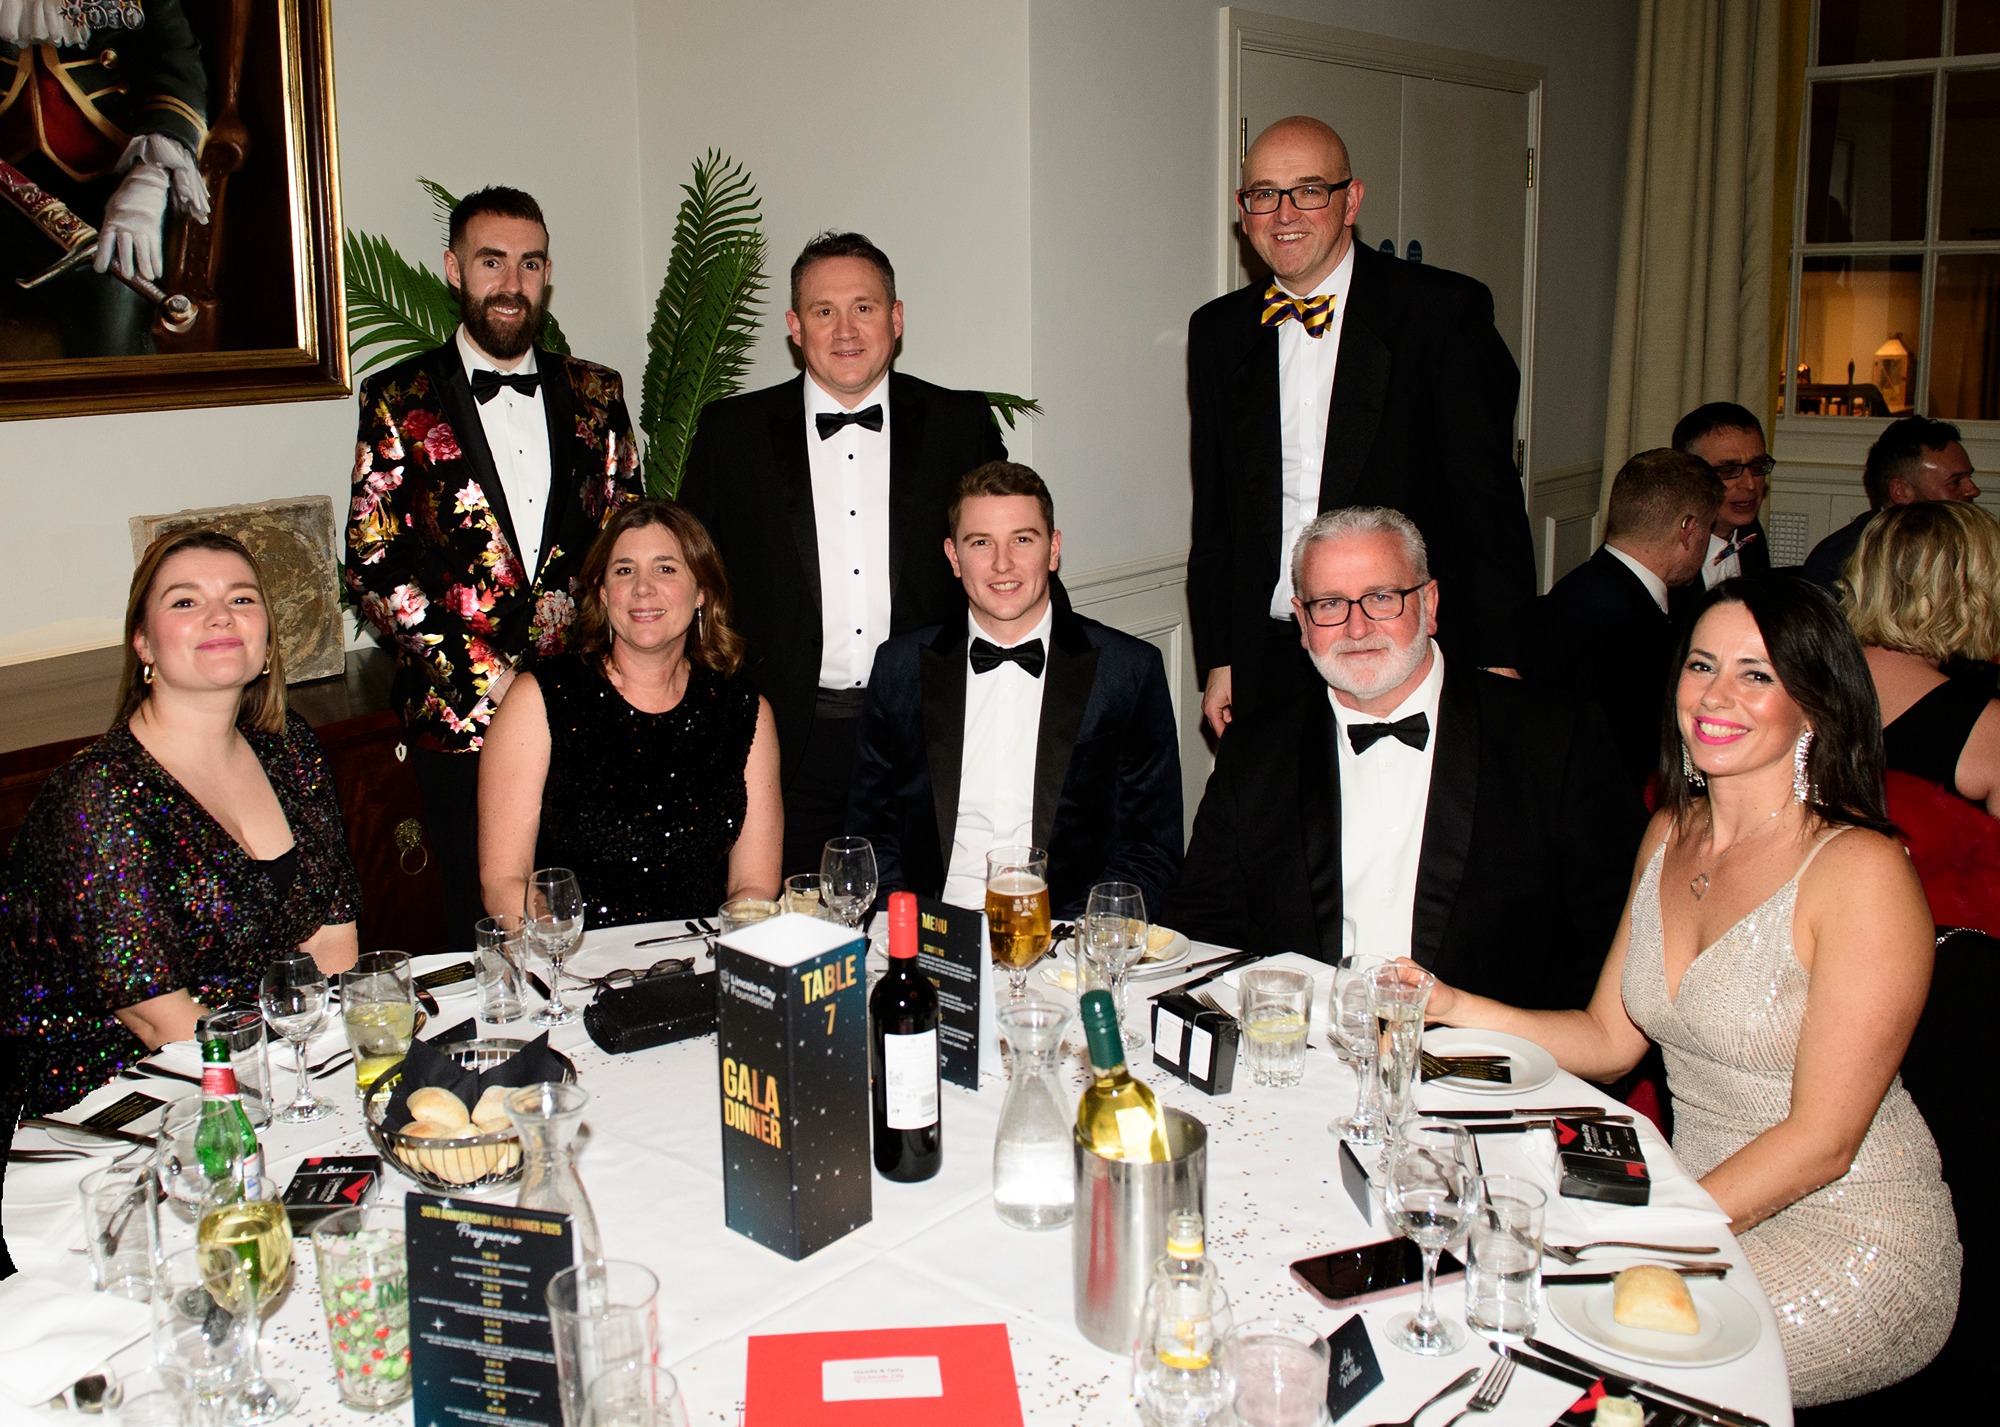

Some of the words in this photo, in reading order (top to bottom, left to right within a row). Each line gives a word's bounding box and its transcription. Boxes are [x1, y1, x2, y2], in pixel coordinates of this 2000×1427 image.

[921, 912, 948, 934] MENU
[730, 974, 759, 994] Lincoln
[759, 985, 777, 1003] City
[800, 954, 857, 1005] TABLE
[730, 985, 774, 1011] Foundation
[824, 1004, 836, 1036] 7
[723, 1057, 780, 1118] GALA
[723, 1097, 782, 1149] DINNER
[420, 1205, 441, 1219] 30TH
[441, 1208, 492, 1226] ANNIVERSARY
[492, 1215, 512, 1229] GALA
[512, 1217, 541, 1232] DINNER
[456, 1221, 523, 1249] Programme
